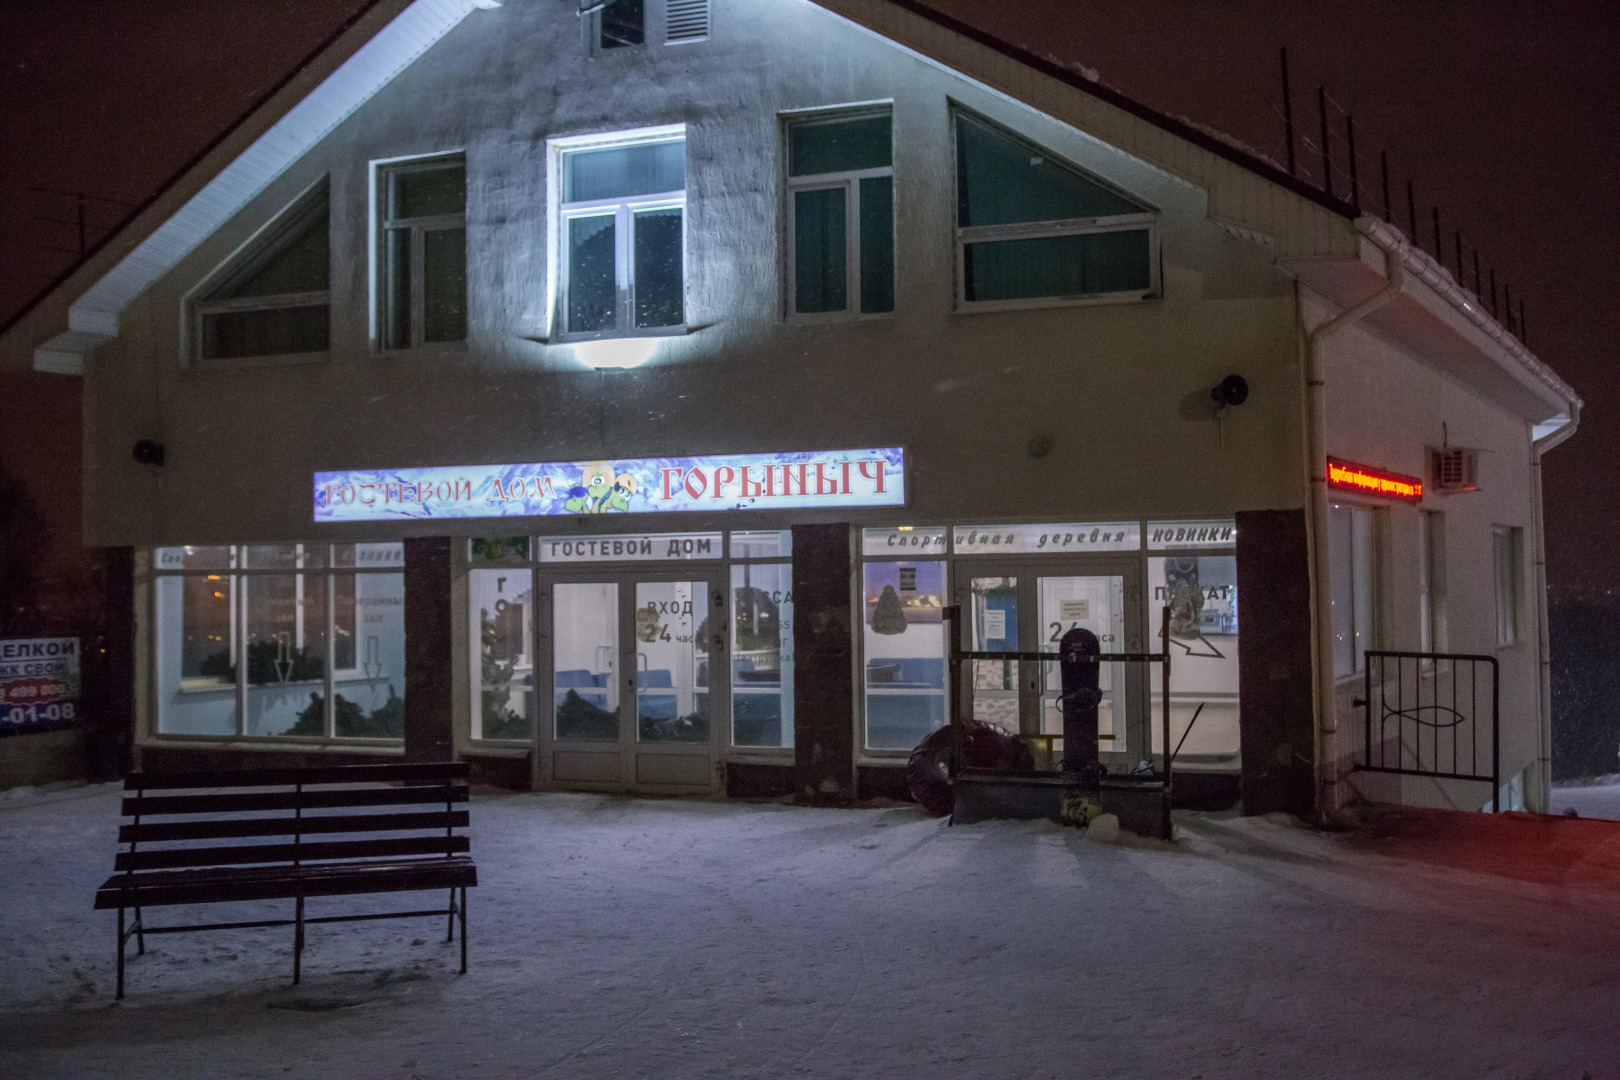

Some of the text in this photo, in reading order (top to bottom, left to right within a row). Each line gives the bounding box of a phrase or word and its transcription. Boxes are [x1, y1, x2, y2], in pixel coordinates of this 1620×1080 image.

[325, 460, 888, 506] ГОСТЕВОЙ ДОМ ГОРЫНЫЧ
[1037, 528, 1125, 548] деревня
[1153, 527, 1232, 542] НОВИНКИ
[551, 536, 711, 557] ГОСТЕВОЙ ДОМ
[642, 623, 672, 643] 24
